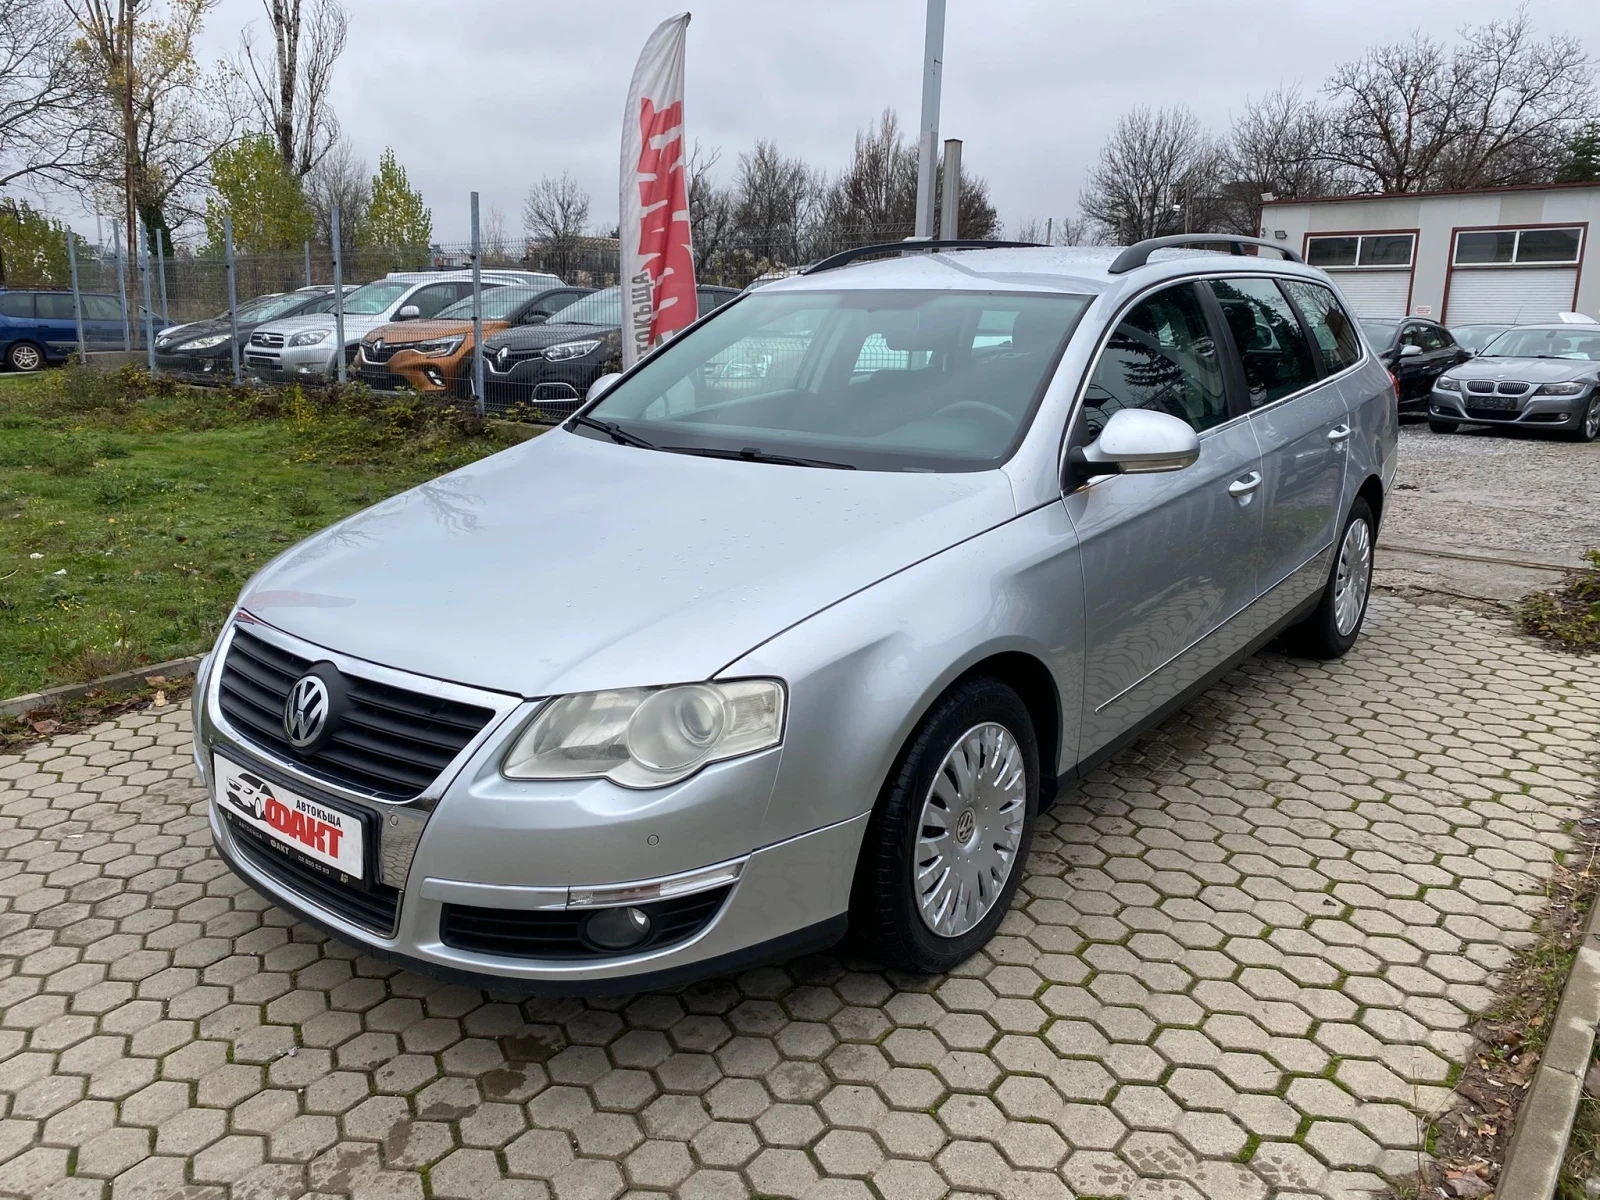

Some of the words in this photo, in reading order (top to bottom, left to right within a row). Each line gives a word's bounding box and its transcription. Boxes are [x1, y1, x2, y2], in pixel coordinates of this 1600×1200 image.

[637, 97, 697, 345] ФАКТ
[631, 272, 653, 361] ТОКЪЩА
[265, 797, 343, 860] ФАКТ
[296, 800, 341, 828] АВТОКЪЩА
[270, 839, 290, 855] ФАКТ
